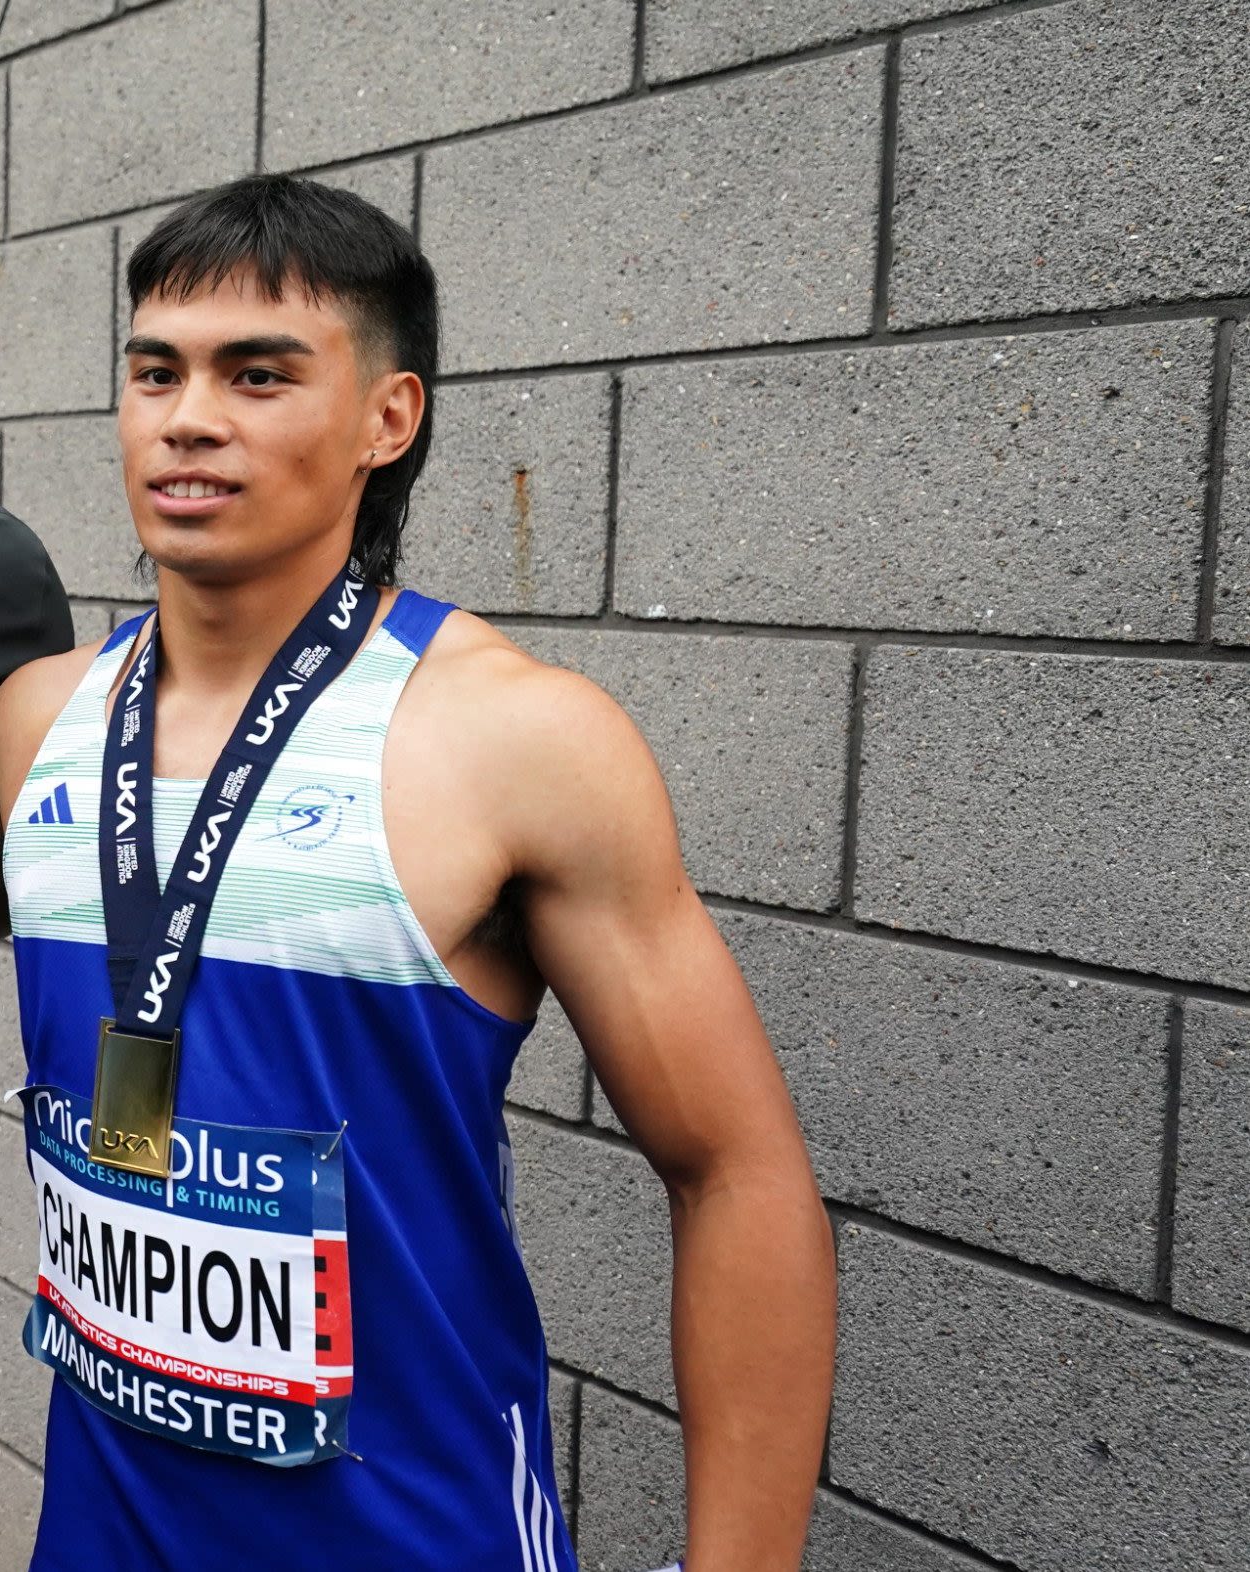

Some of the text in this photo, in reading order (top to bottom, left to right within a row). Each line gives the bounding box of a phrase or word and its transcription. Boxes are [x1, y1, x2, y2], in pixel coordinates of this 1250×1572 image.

[328, 579, 364, 630] UKA
[291, 647, 312, 670] UNITED
[297, 644, 323, 674] KINGDOM
[304, 645, 332, 678] ATHLETICS
[245, 683, 303, 745] UKA
[116, 762, 138, 836] UKA
[220, 771, 236, 797] UNITED
[226, 766, 245, 800] KINGDOM
[232, 764, 253, 802] ATHLETICS
[116, 845, 127, 885] ATHLETICS
[123, 844, 133, 879] KINGDOM
[129, 843, 138, 871] UNITED
[187, 810, 232, 882] UKA
[166, 910, 180, 937] UNITED
[172, 904, 189, 940] KINGDOM
[178, 903, 196, 942] ATHLETICS
[137, 951, 179, 1023] UKA
[100, 1127, 159, 1159] UKA
[39, 1130, 280, 1218] DATA PROCESSING & TIMING
[42, 1182, 291, 1352] CHAMPION
[49, 1285, 290, 1396] UK ATHLETICS CHAMPIONSHIPS
[40, 1313, 287, 1455] MANCHESTER
